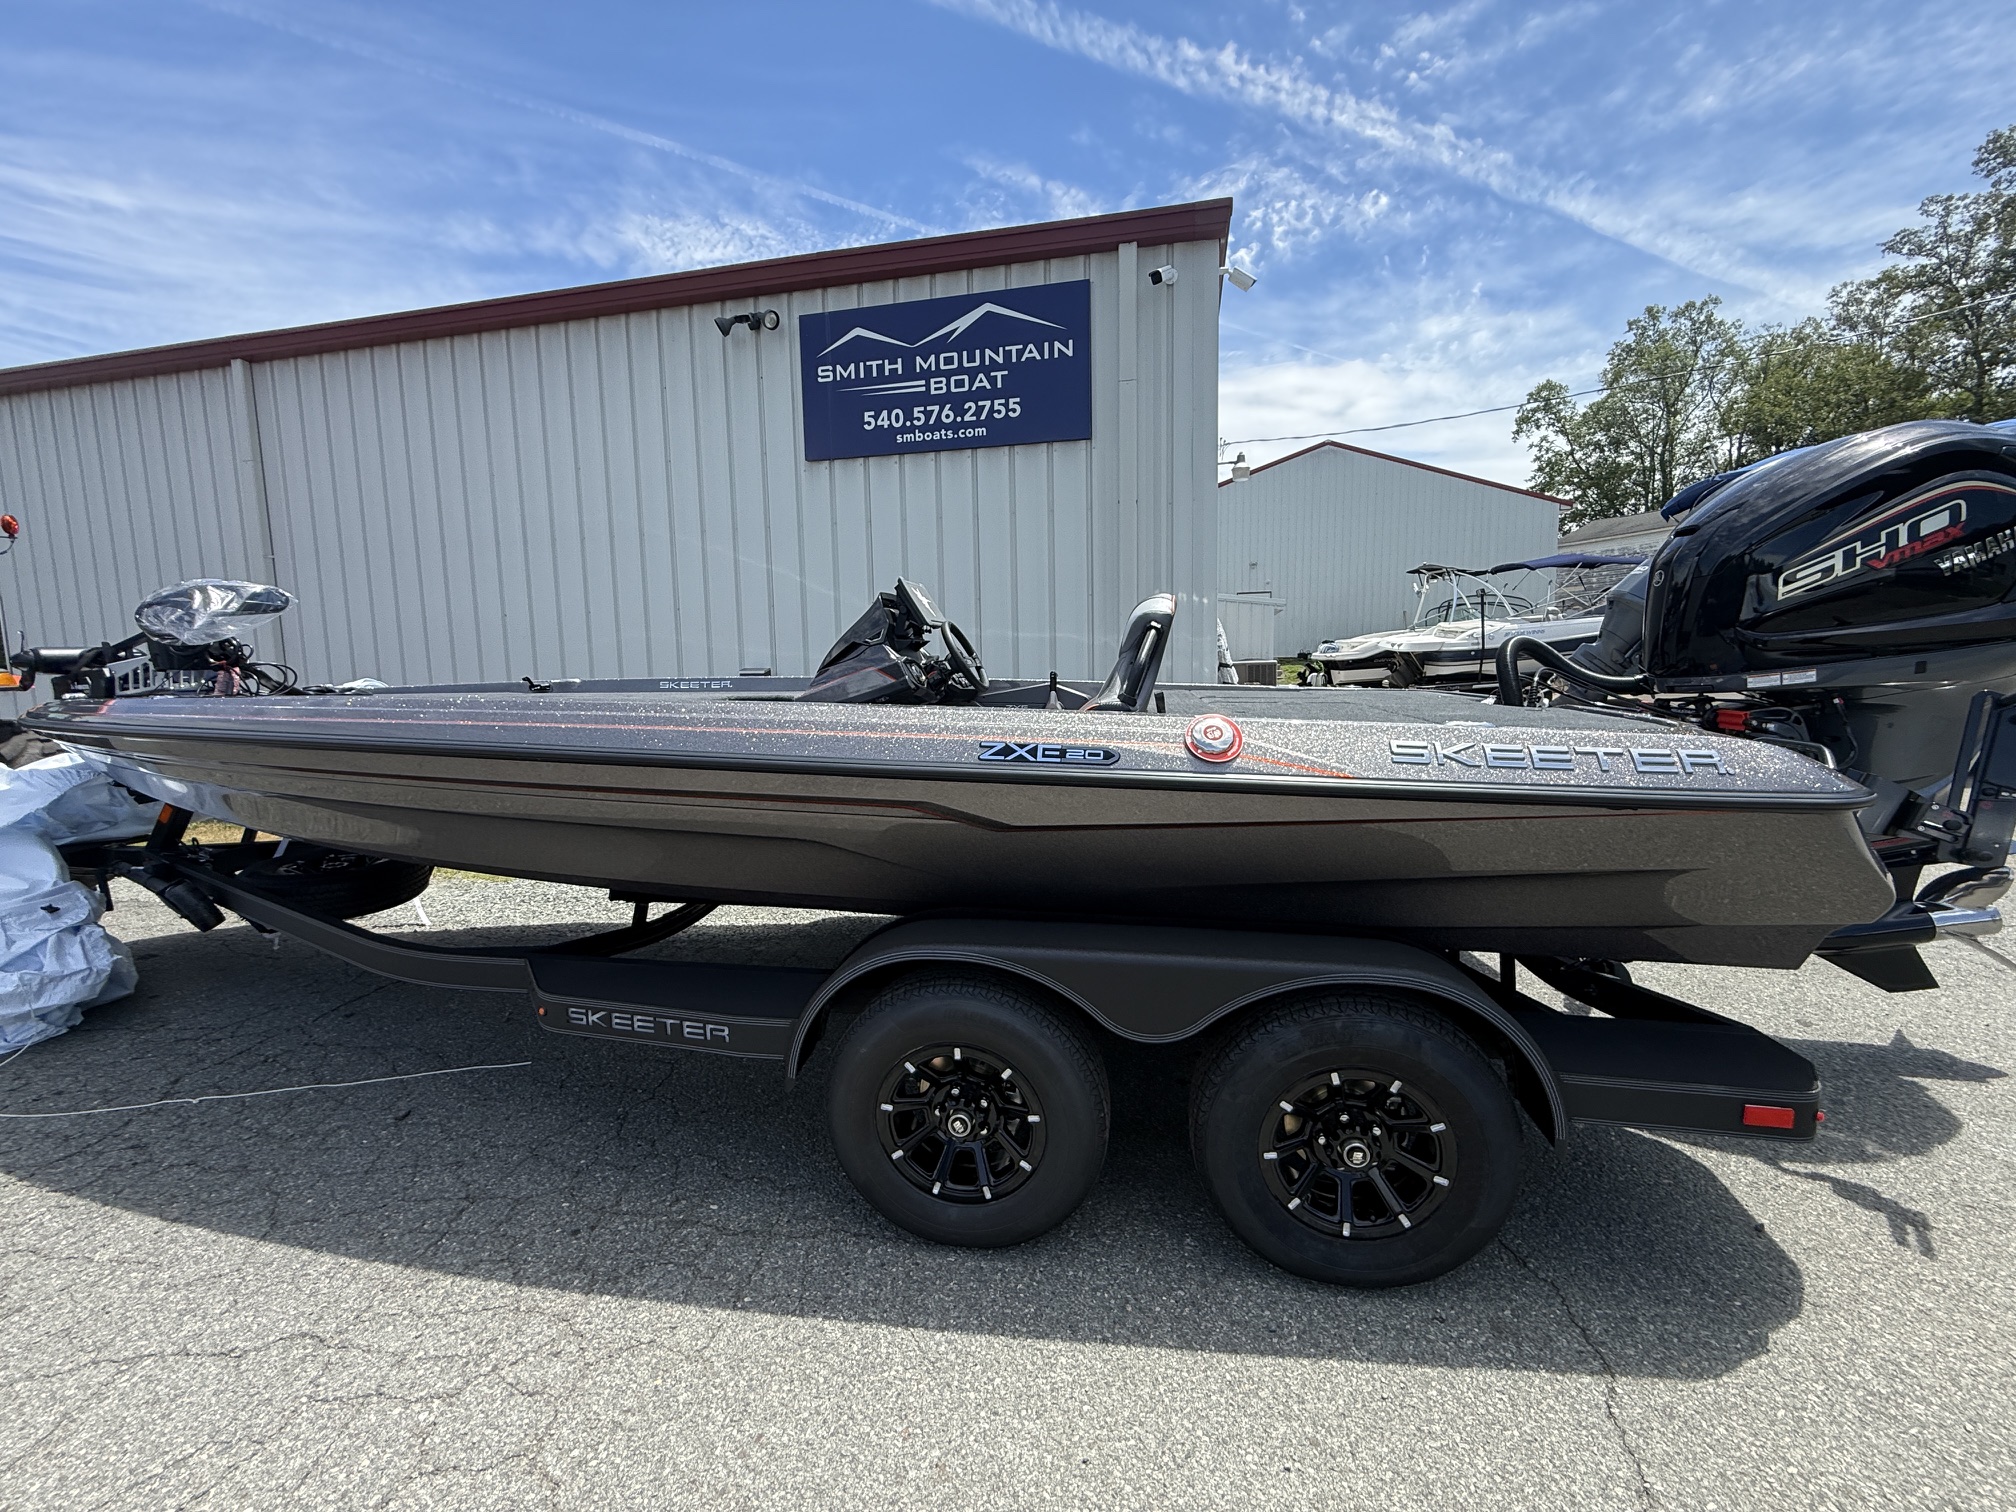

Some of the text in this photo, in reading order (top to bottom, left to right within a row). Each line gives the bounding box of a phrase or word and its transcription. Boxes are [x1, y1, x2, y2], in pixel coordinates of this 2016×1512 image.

[817, 339, 1074, 383] SMITH MOUNTAIN
[930, 370, 1009, 395] BOAT
[863, 397, 1022, 430] 540.576.2755
[896, 427, 987, 443] smboats.com
[1778, 500, 1967, 601] SHO
[1934, 526, 2016, 577] YAMAH
[979, 742, 1104, 762] ZXE 20
[567, 1007, 730, 1043] SKEETER
